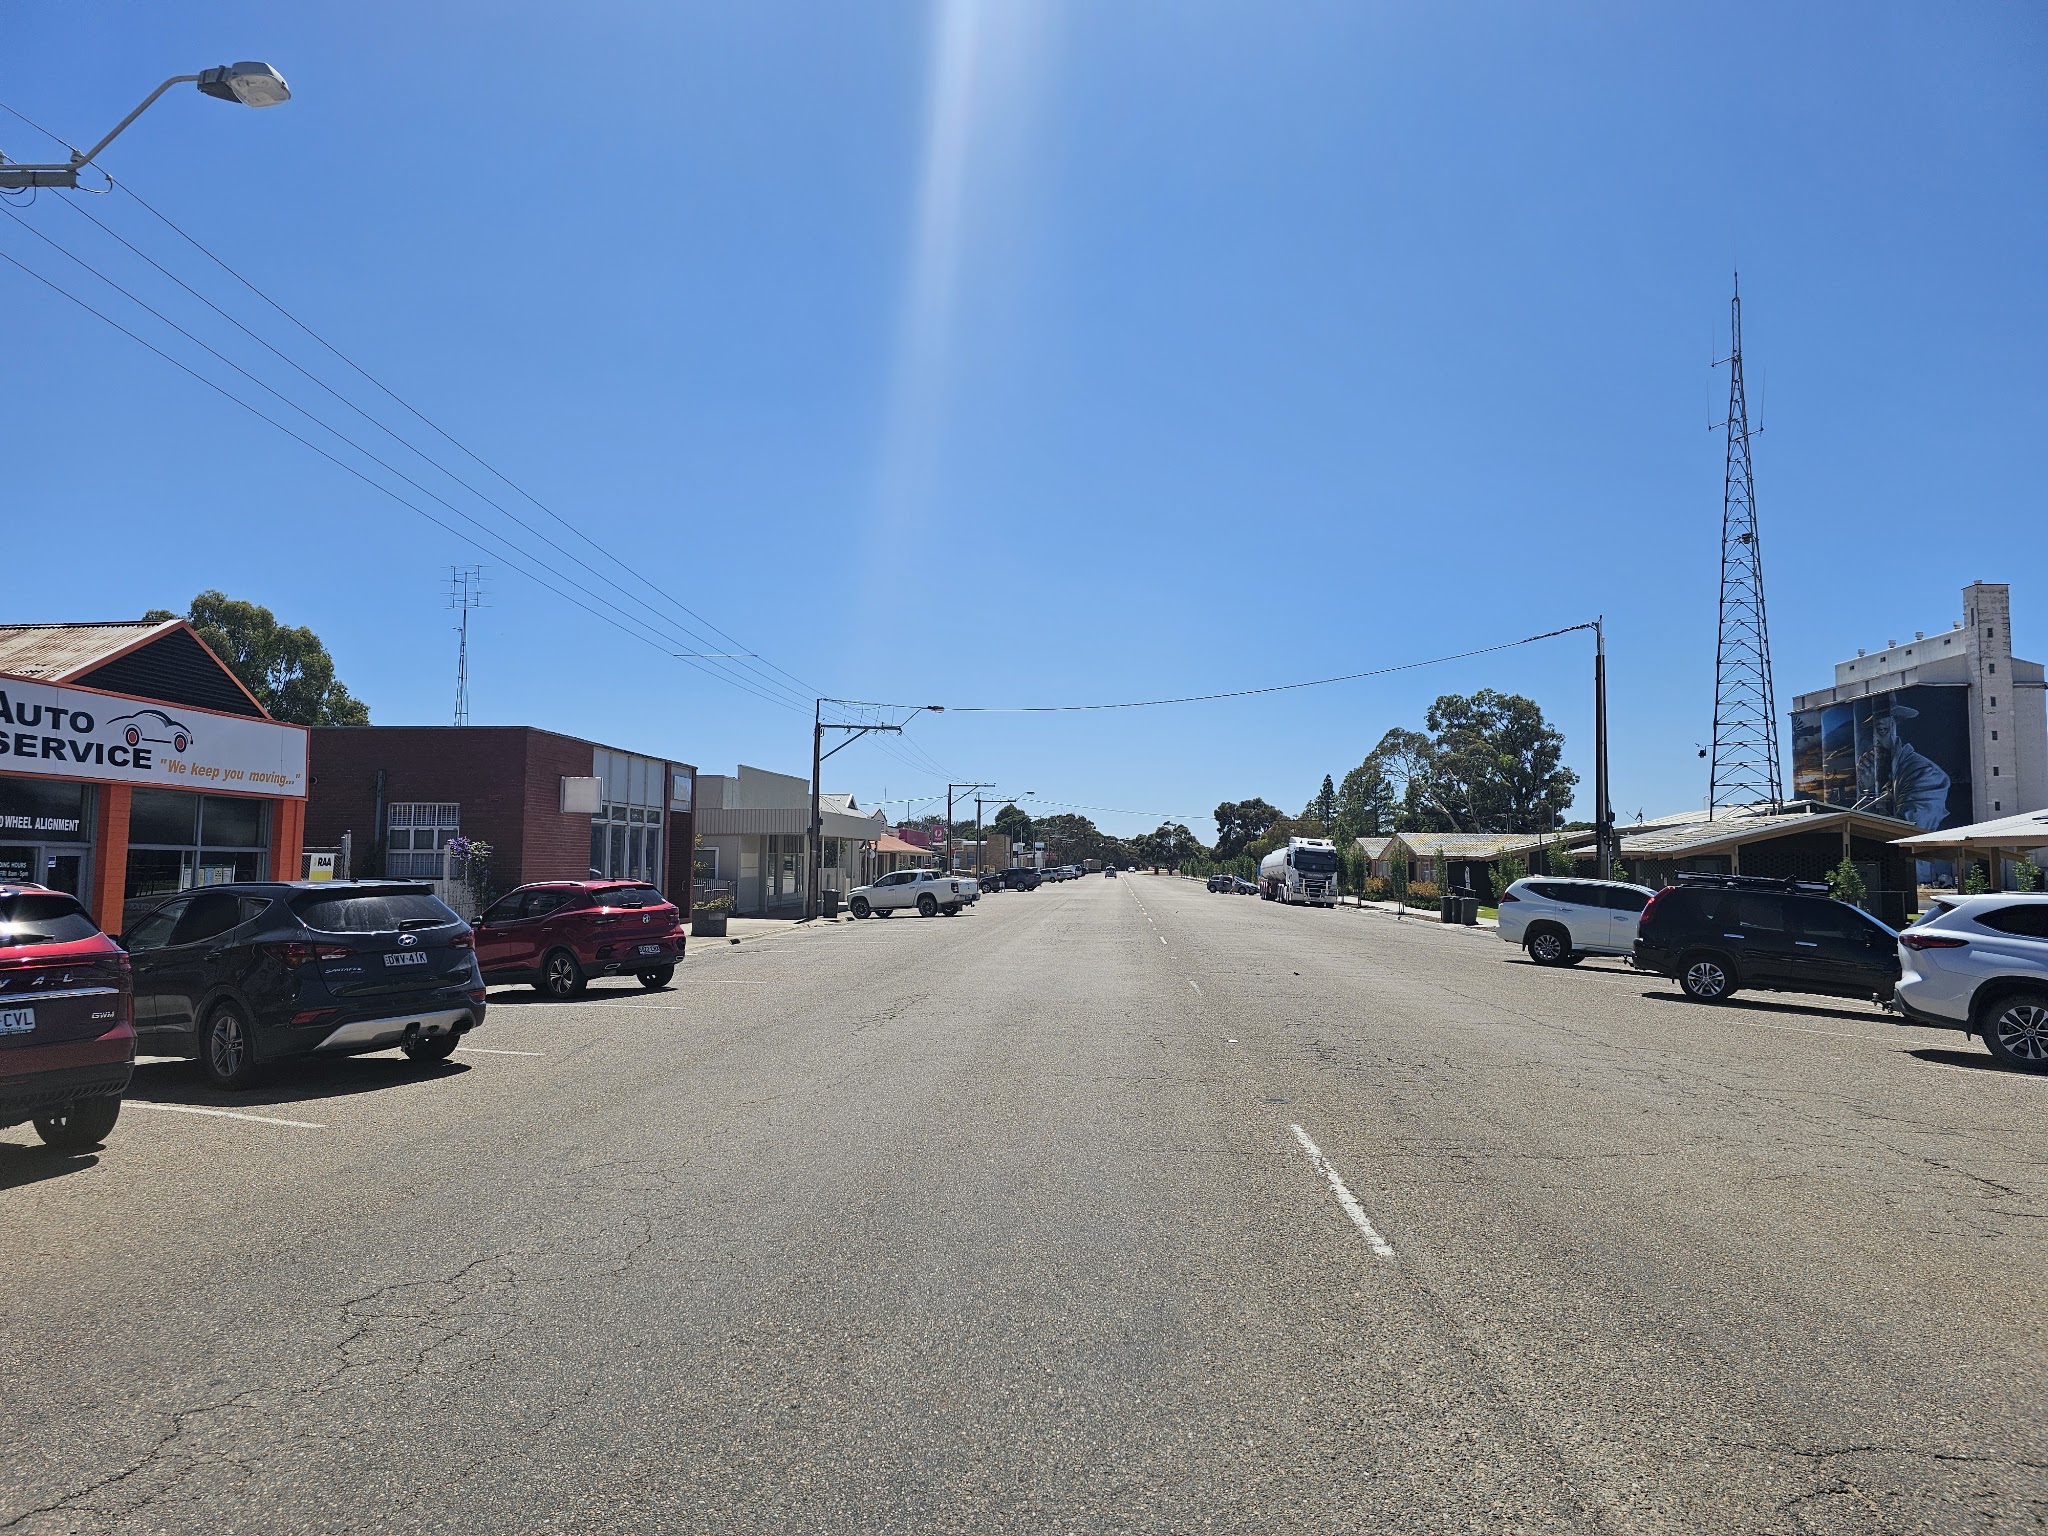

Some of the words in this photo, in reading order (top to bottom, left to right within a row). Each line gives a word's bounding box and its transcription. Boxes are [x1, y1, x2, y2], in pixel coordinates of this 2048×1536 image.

[191, 763, 219, 780] keep
[223, 769, 244, 781] you
[5, 815, 32, 829] WHEEL
[35, 817, 79, 831] ALIGNMENT
[317, 857, 332, 867] RAA
